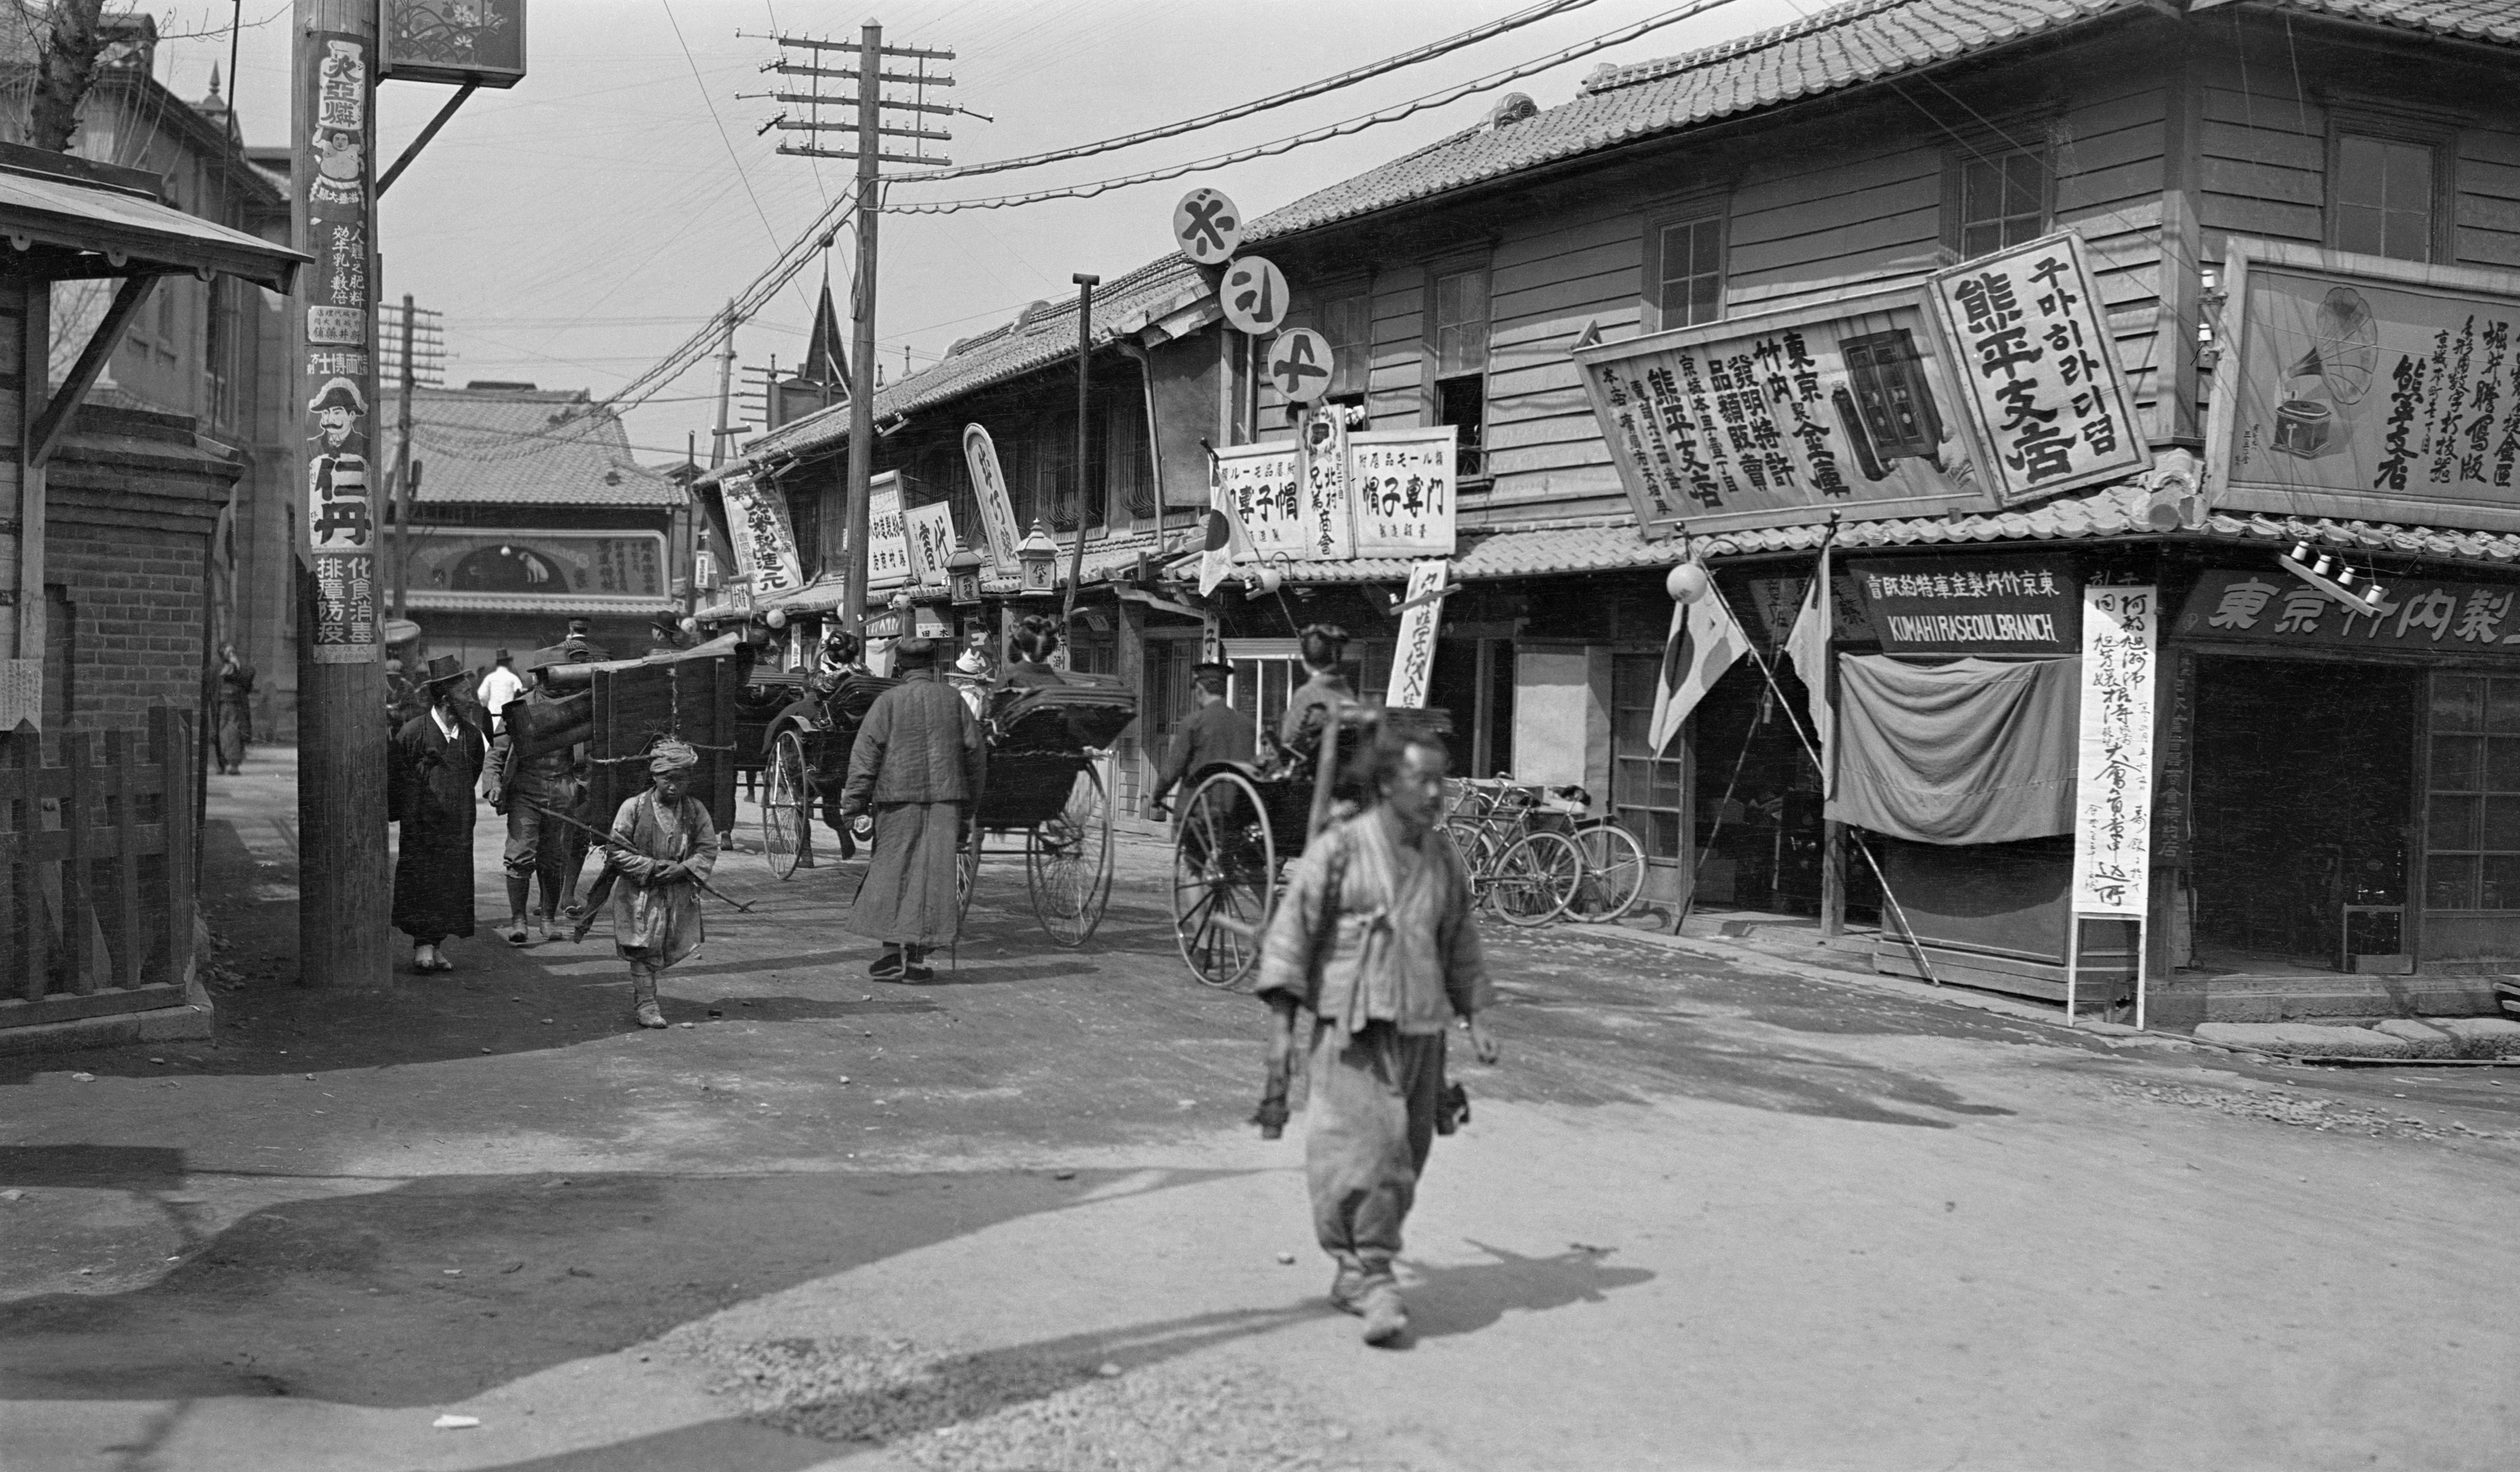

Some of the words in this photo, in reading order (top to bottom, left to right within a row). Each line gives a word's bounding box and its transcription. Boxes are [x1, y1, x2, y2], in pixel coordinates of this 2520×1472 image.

[1955, 273, 2076, 484] 熊平支店
[1647, 367, 1723, 509] 熊平支店
[314, 458, 372, 545] 仁丹
[348, 558, 373, 644] 化食消毒
[2208, 577, 2520, 645] 東京竹内製
